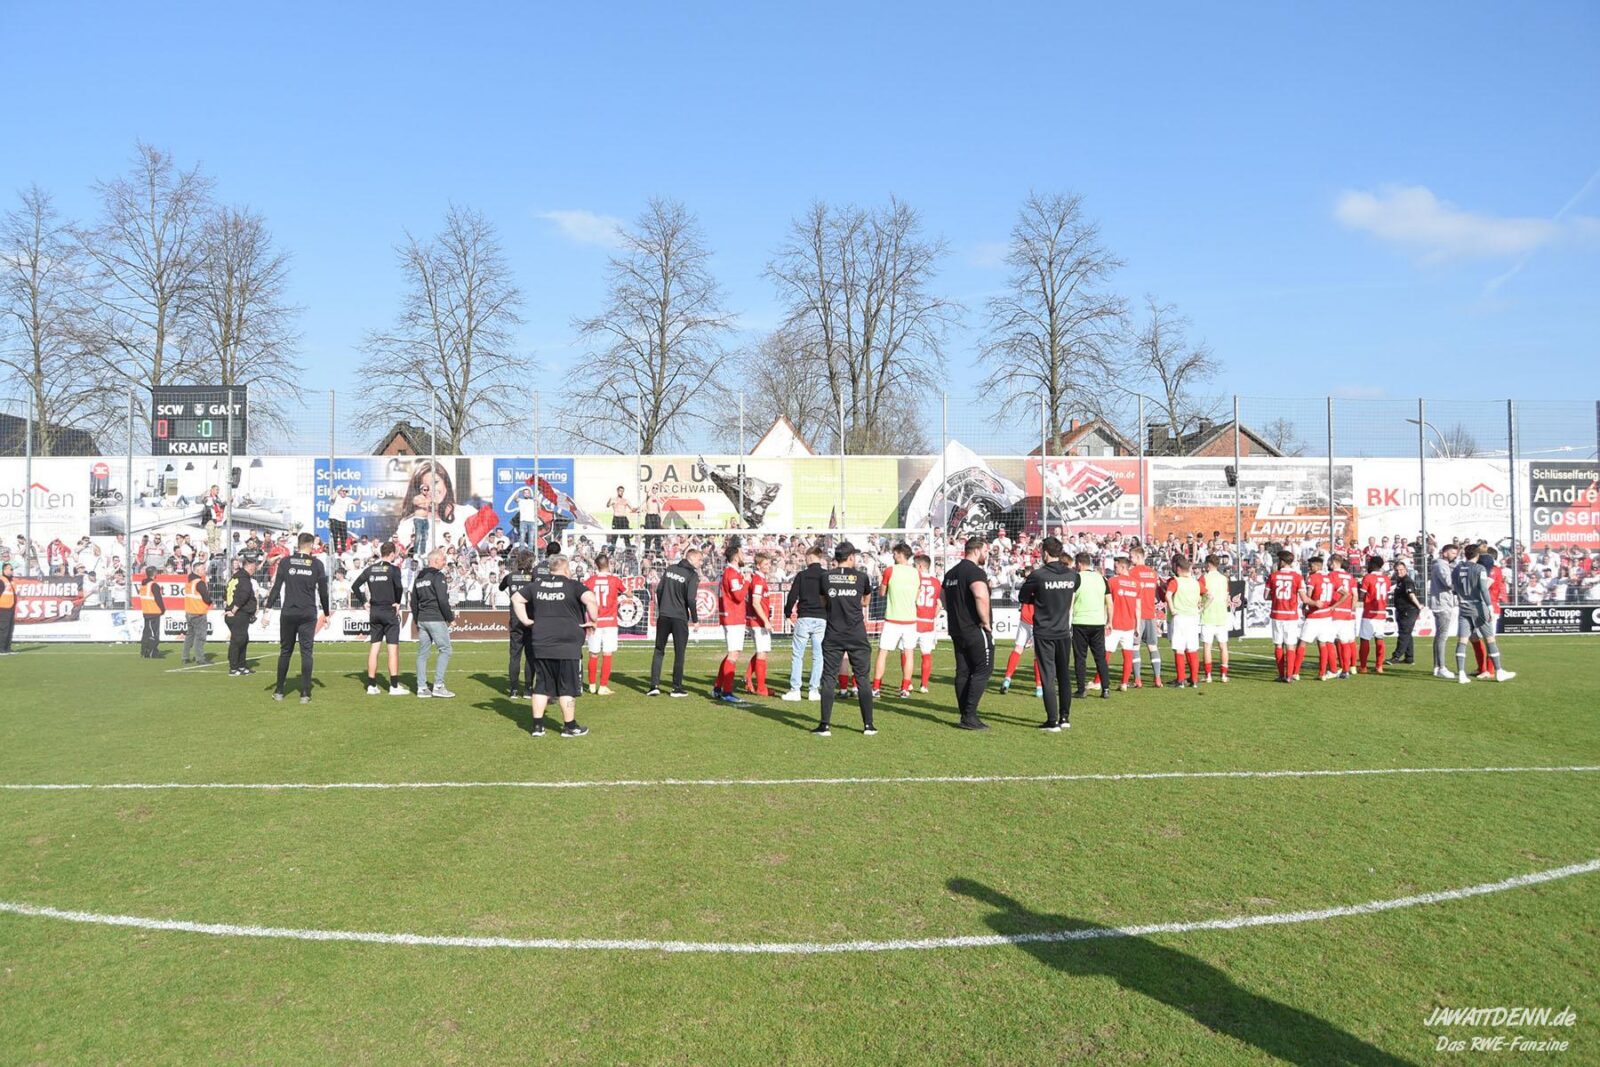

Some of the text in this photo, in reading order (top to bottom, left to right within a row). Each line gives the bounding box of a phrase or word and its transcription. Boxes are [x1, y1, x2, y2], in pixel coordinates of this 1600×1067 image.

[157, 404, 241, 415] SCW GAST
[168, 442, 228, 454] KRAMER
[316, 468, 361, 480] Schicke
[515, 470, 568, 482] Muerring
[1533, 484, 1598, 503] André
[361, 500, 378, 512] Sie
[1249, 521, 1345, 535] LANDWEHR
[1549, 608, 1581, 619] Gruppe
